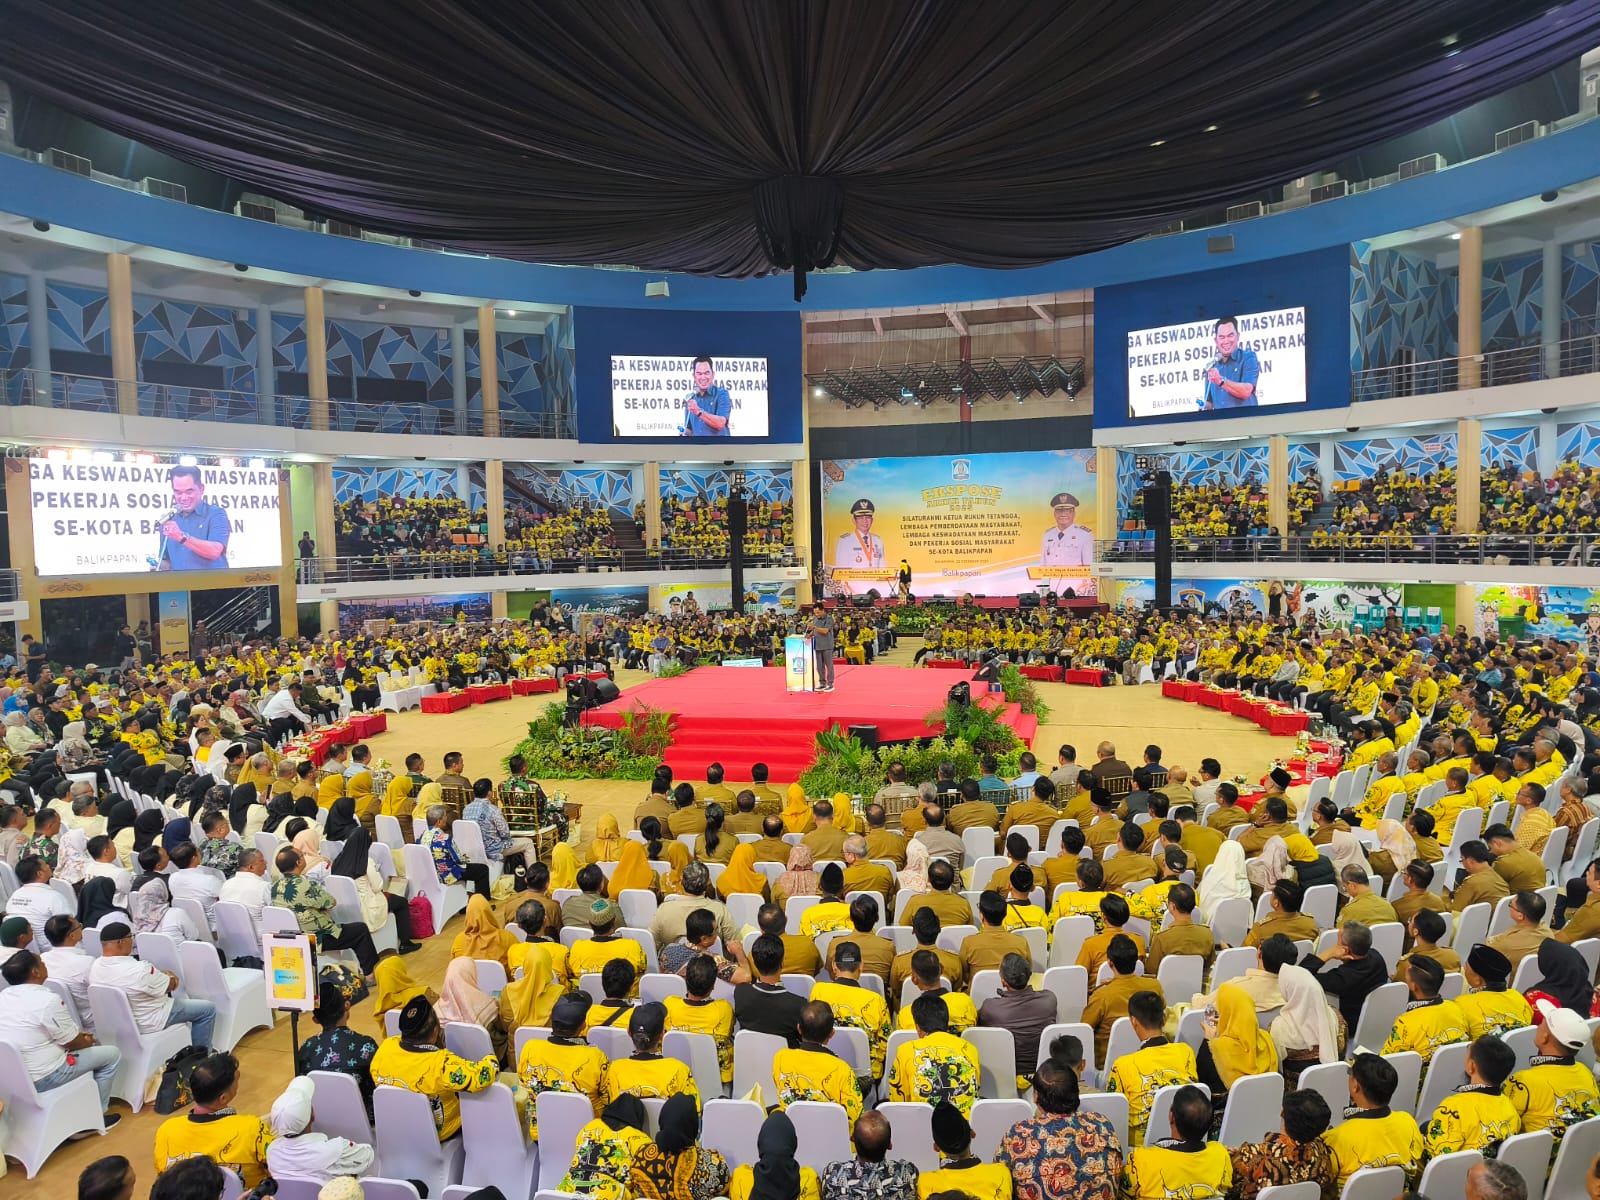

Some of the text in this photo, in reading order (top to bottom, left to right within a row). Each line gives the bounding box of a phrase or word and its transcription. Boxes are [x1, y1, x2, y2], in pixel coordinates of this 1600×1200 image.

[1146, 324, 1217, 345] KESWADAYA
[1241, 312, 1304, 332] MASYARA
[629, 360, 695, 371] KESWADAYA
[715, 361, 766, 372] MASYARA
[1129, 350, 1180, 368] PEKERJA
[1184, 346, 1221, 361] SOSIA
[613, 379, 662, 390] PEKERJA
[666, 379, 697, 391] SOSIA
[1140, 370, 1188, 388] SE-KOTA
[624, 398, 670, 410] SE-KOTA
[62, 465, 172, 483] KESWADAYA
[204, 470, 278, 485] MASYARA
[32, 491, 120, 508] PEKERJA
[126, 493, 176, 509] SOSIA
[921, 484, 1003, 502] EKSPOSE
[53, 519, 133, 536] SE-KOTA
